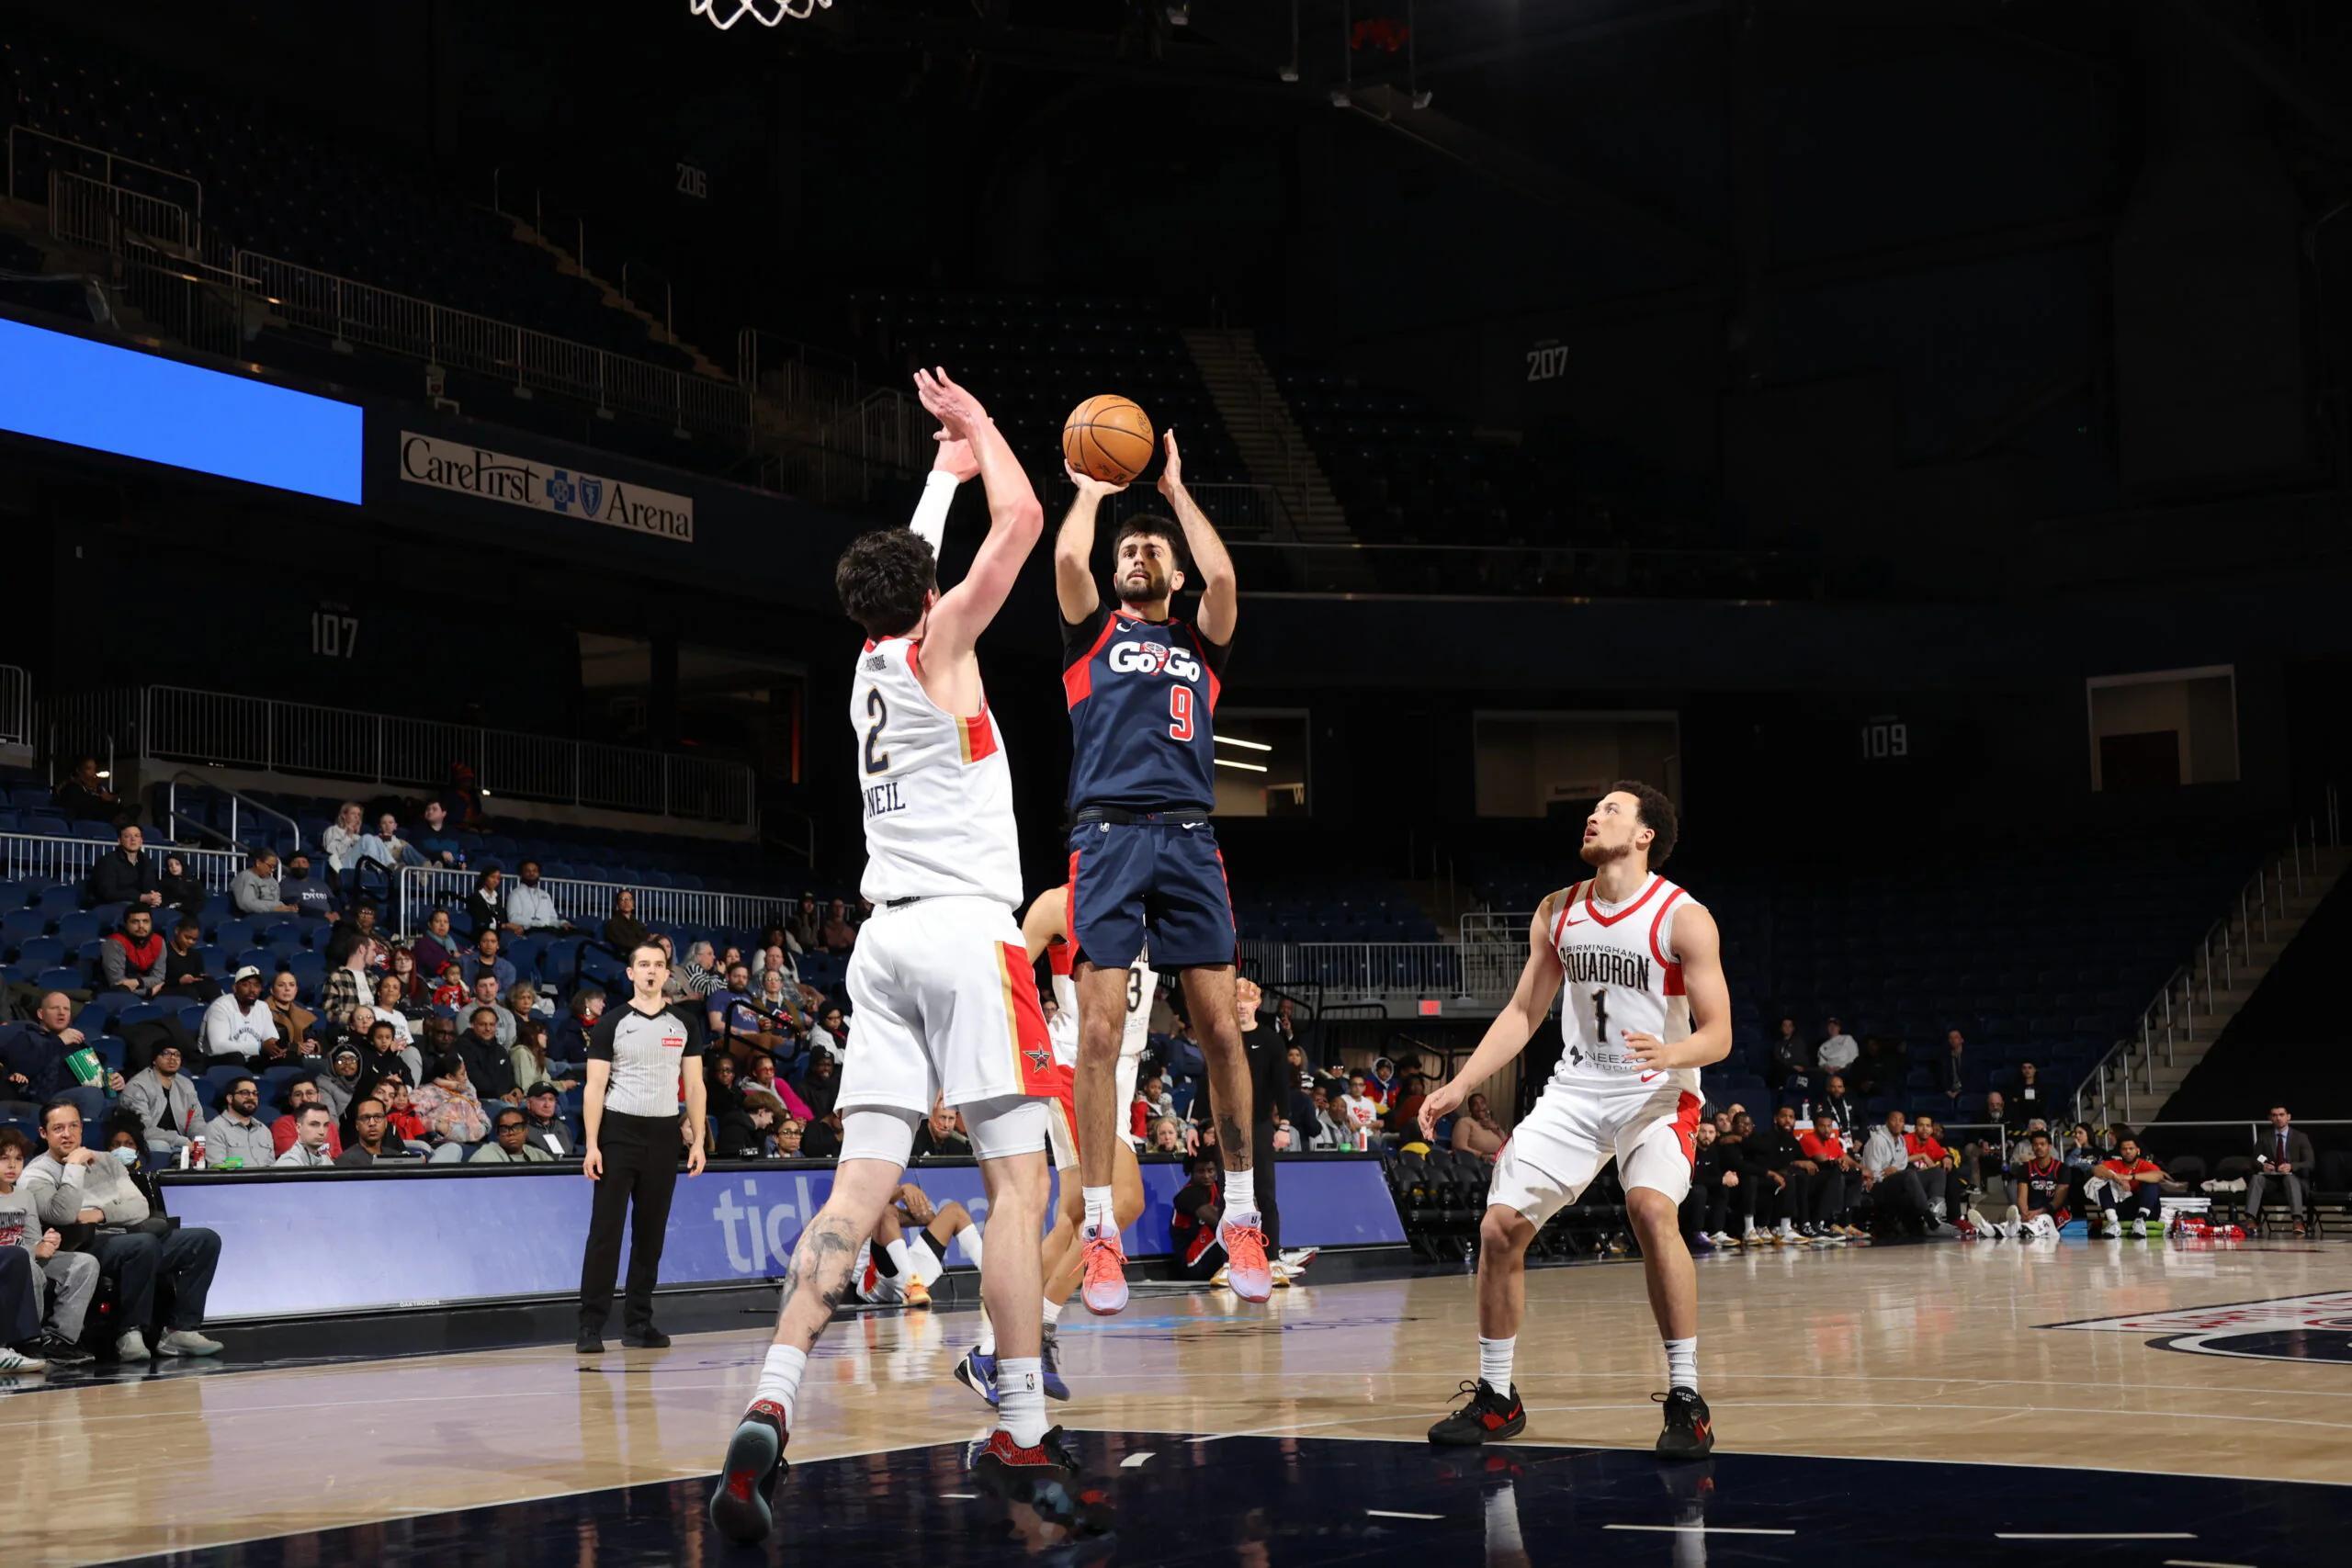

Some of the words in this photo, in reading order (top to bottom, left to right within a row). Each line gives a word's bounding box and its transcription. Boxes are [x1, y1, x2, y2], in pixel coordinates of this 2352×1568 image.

[1527, 345, 1569, 382] 207
[403, 437, 539, 504] CareFirst
[606, 483, 690, 537] Arena
[311, 611, 359, 659] 107
[865, 686, 889, 776] 2
[1170, 684, 1193, 741] 9
[1861, 723, 1907, 760] 109
[1559, 947, 1650, 992] SQUADRON
[1566, 943, 1635, 960] BIRMINGHAM
[1591, 987, 1609, 1043] 1
